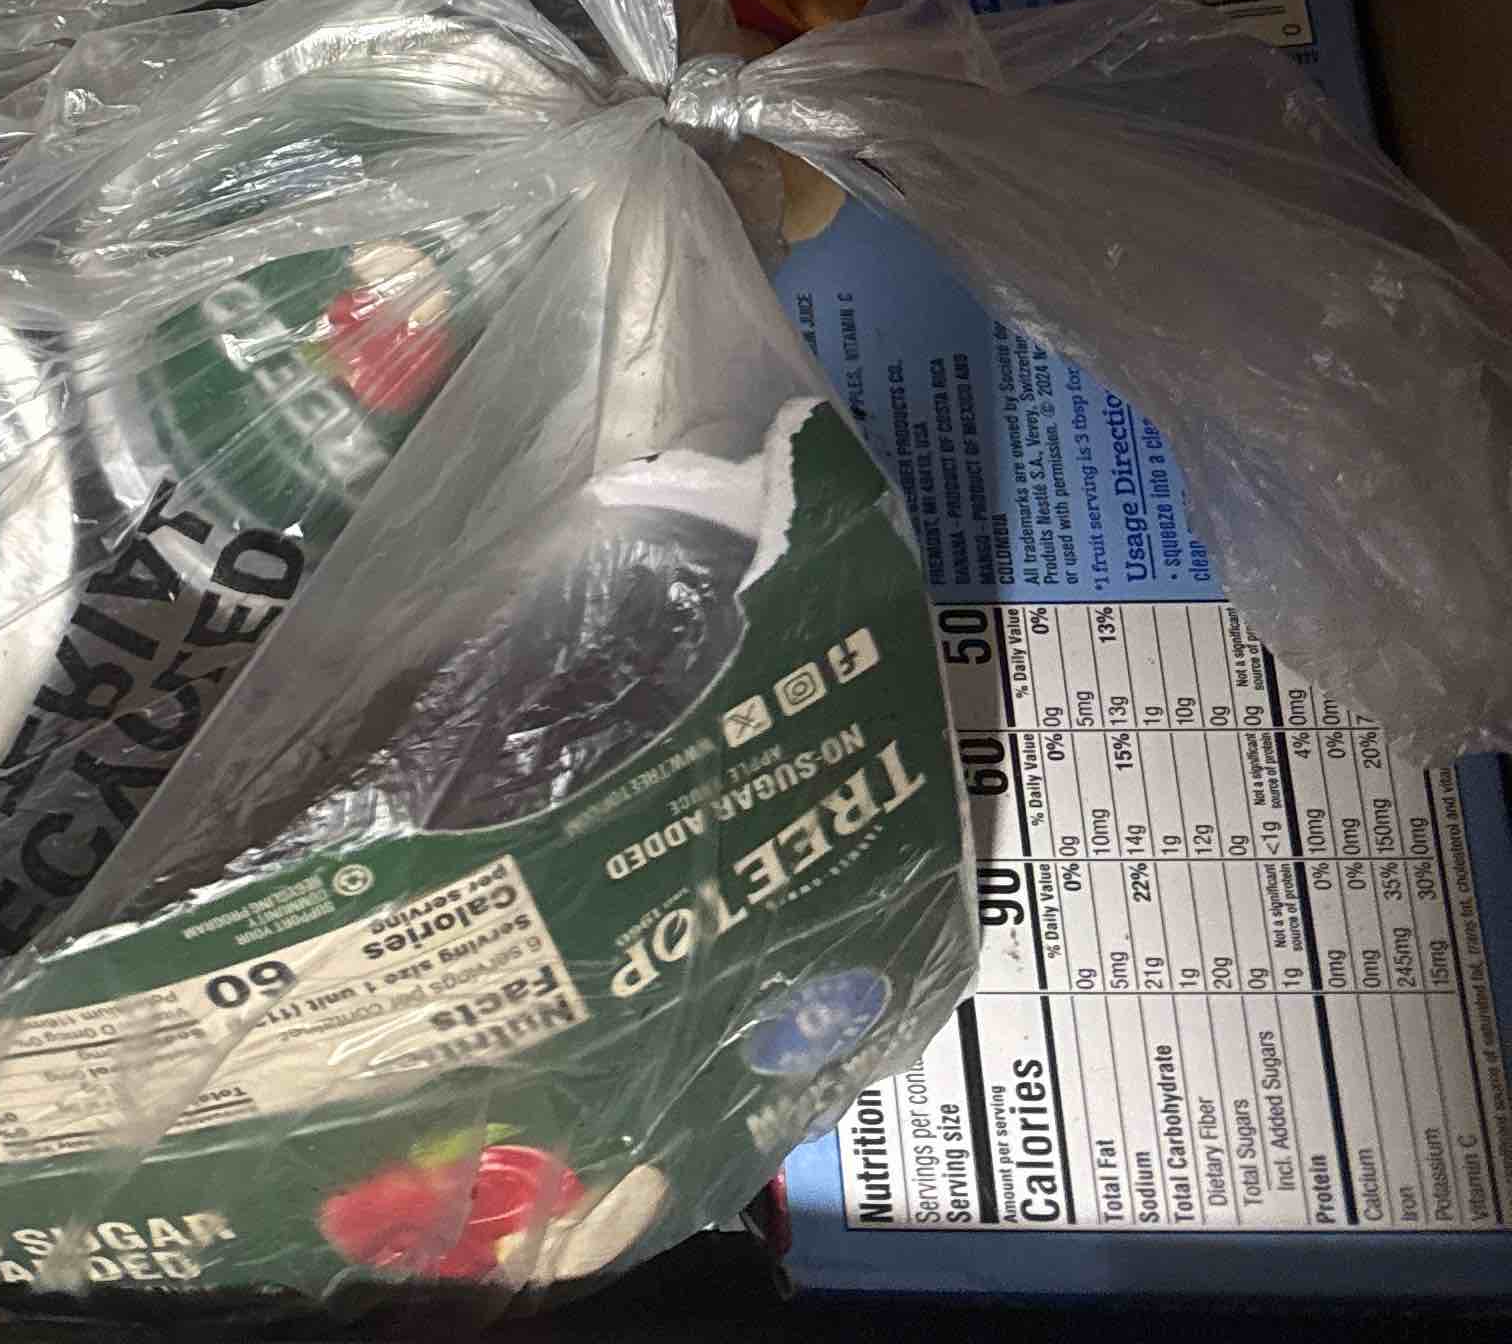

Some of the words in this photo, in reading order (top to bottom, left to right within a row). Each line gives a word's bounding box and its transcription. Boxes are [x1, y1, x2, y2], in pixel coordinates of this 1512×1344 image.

[1065, 367, 1081, 390] for
[1071, 394, 1088, 429] tbsp
[1074, 433, 1089, 443] 3
[1076, 446, 1092, 460] is
[1081, 465, 1102, 529] serving
[1088, 533, 1108, 572] fruit
[1121, 502, 1147, 582] Usage
[714, 723, 864, 820] NO-SUGAR
[606, 810, 703, 879] ADDED
[208, 960, 295, 1009] 60
[936, 1103, 962, 1141] size
[1155, 1044, 1187, 1169] Carbohydrate
[854, 1089, 896, 1224] Nutrition
[1008, 1059, 1059, 1221] Calories
[942, 1149, 970, 1222] Serving
[1135, 1151, 1159, 1222] Sodium
[1167, 1176, 1194, 1221] Total
[1309, 1154, 1334, 1222] Protein
